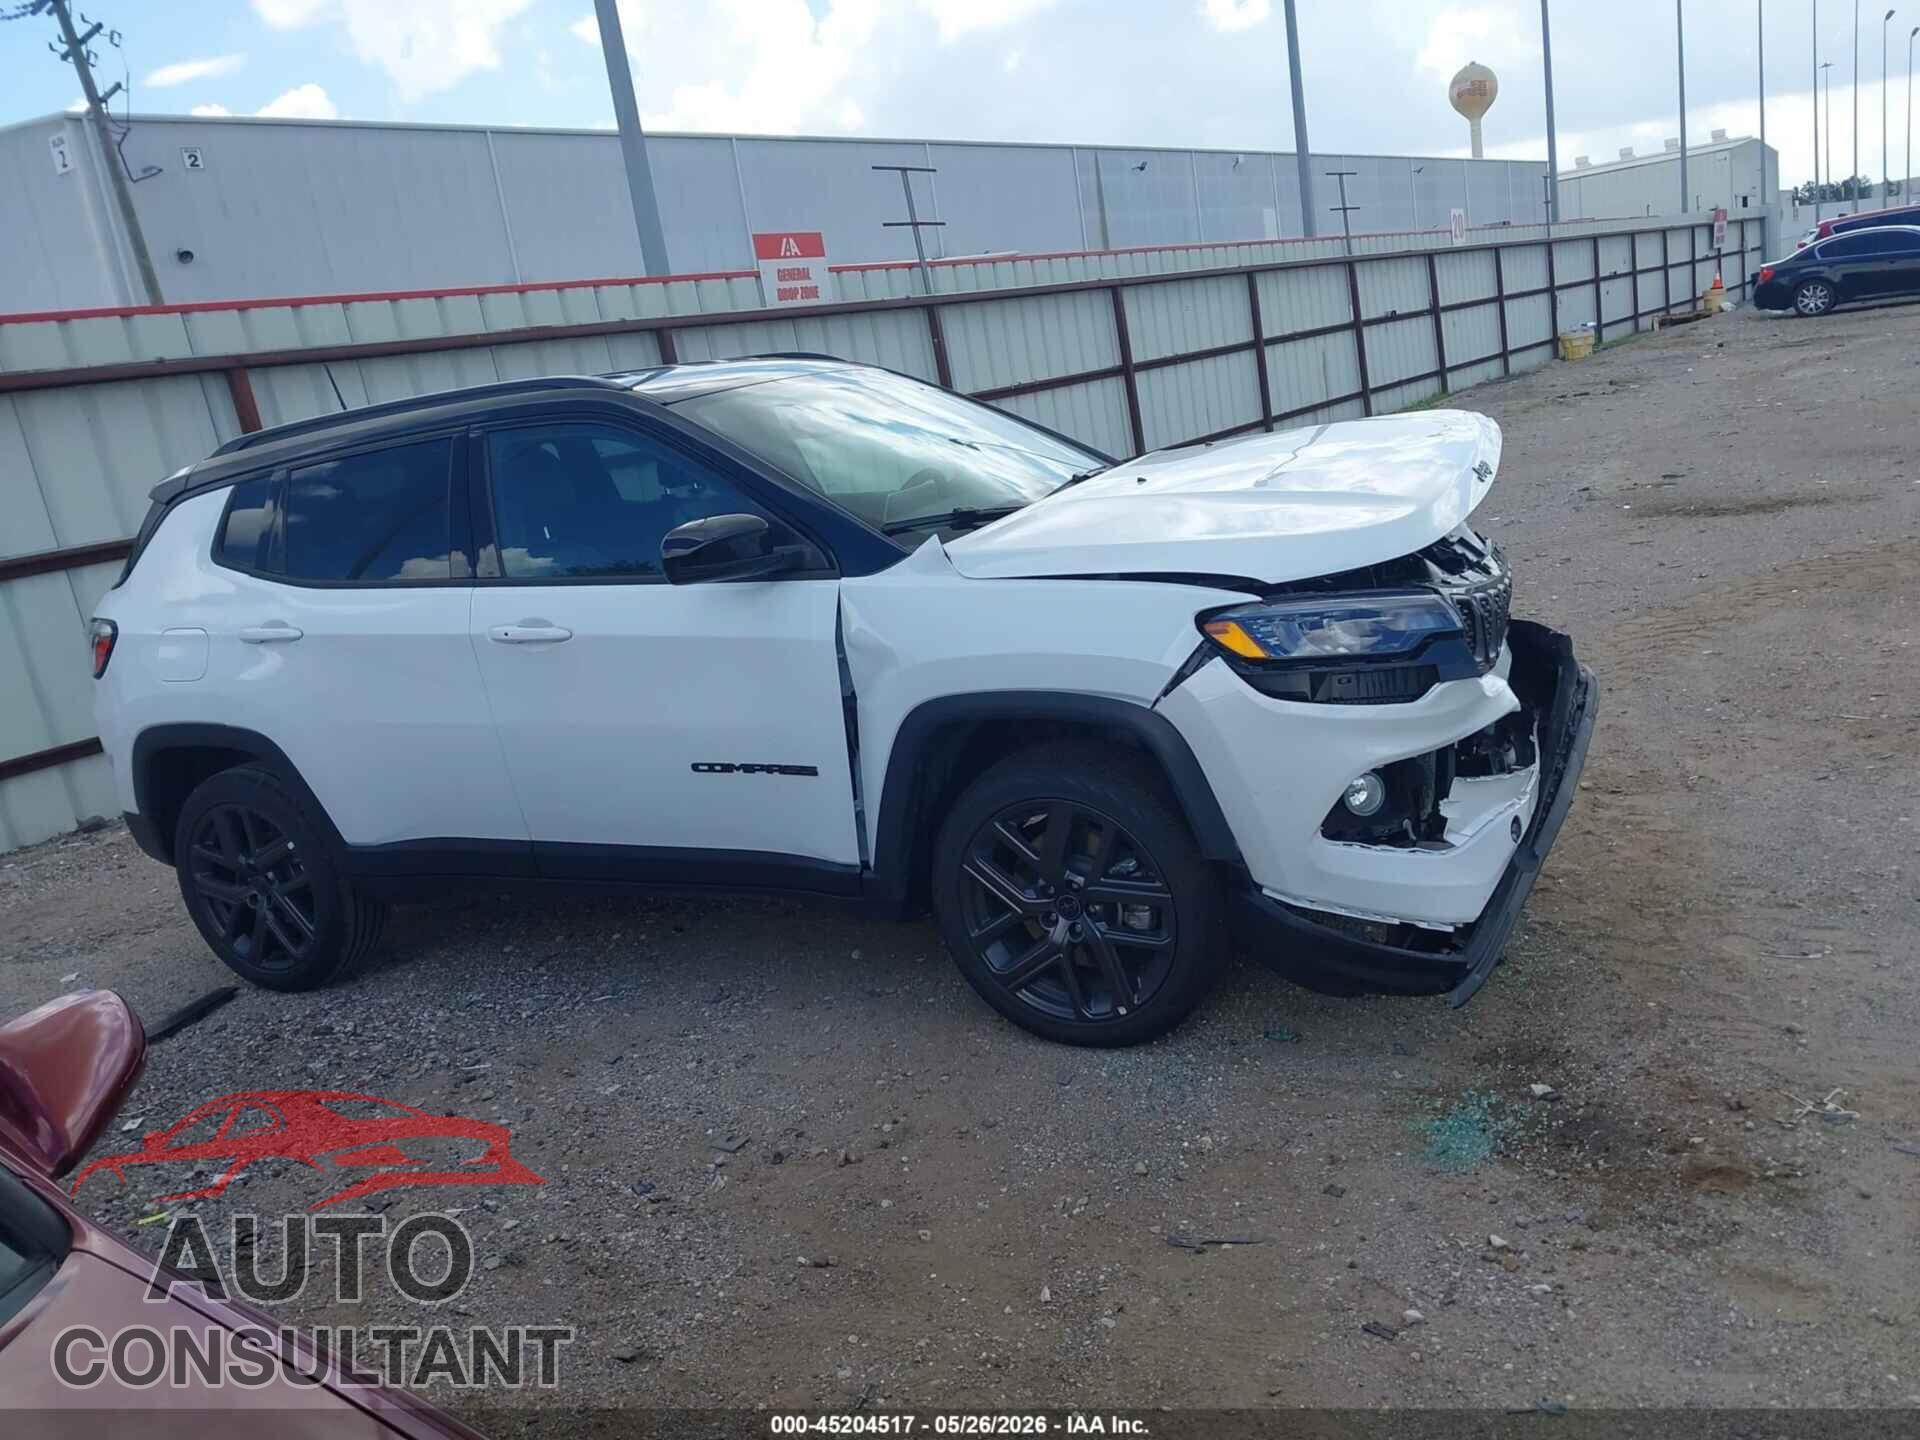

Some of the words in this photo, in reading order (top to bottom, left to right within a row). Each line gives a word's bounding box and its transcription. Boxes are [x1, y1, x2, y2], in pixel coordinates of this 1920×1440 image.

[188, 153, 200, 167] 2
[777, 267, 812, 282] GENERAL
[777, 286, 800, 301] DROP
[800, 285, 820, 299] ZONE
